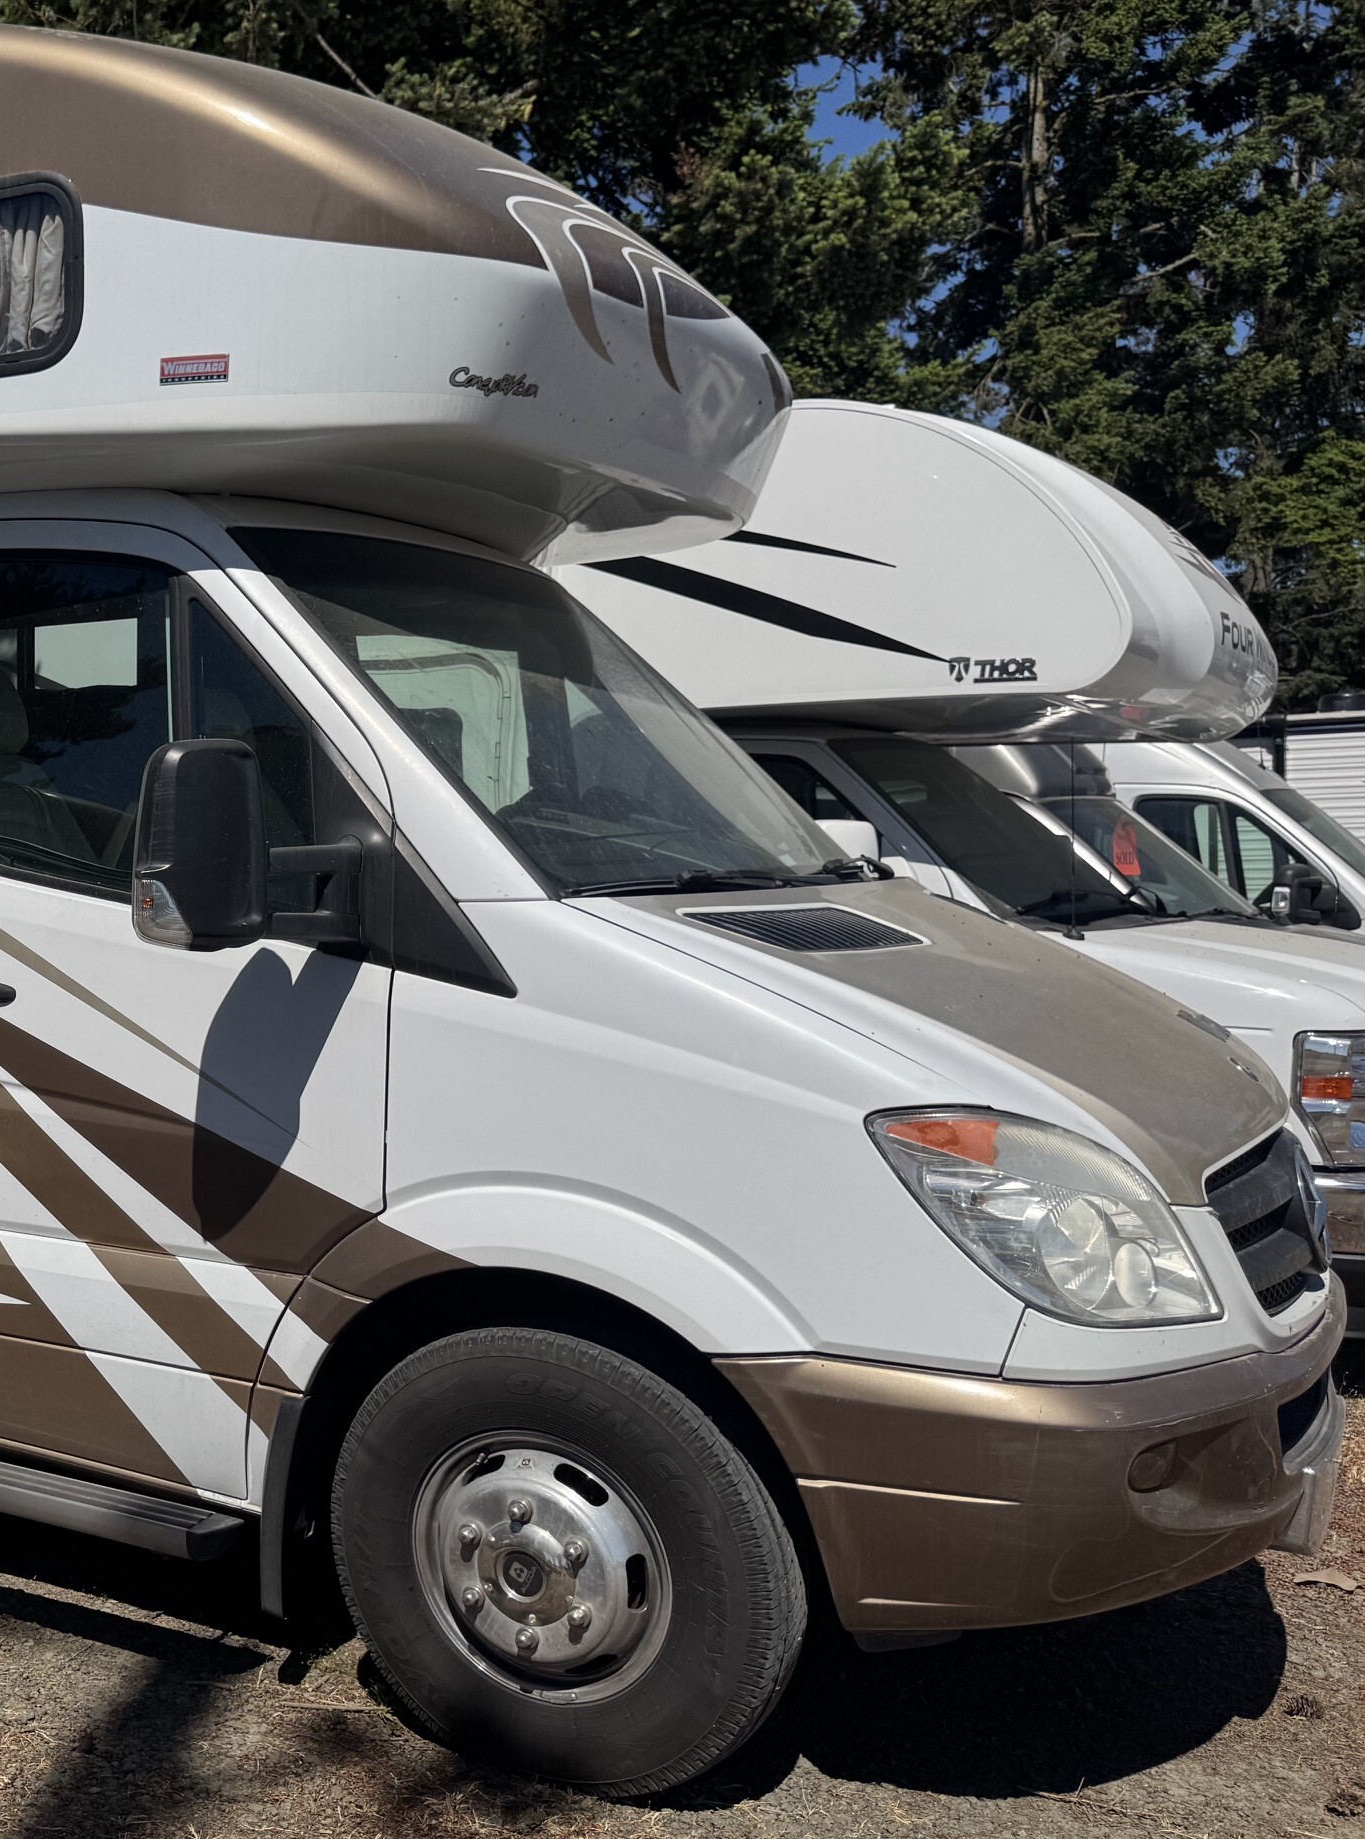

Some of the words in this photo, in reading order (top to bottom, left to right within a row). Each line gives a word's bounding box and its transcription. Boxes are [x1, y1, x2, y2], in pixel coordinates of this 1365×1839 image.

[162, 360, 225, 375] WINNEBAGO
[1220, 611, 1255, 656] FOUR
[974, 658, 1037, 679] THOR
[505, 1373, 641, 1440] OPEN
